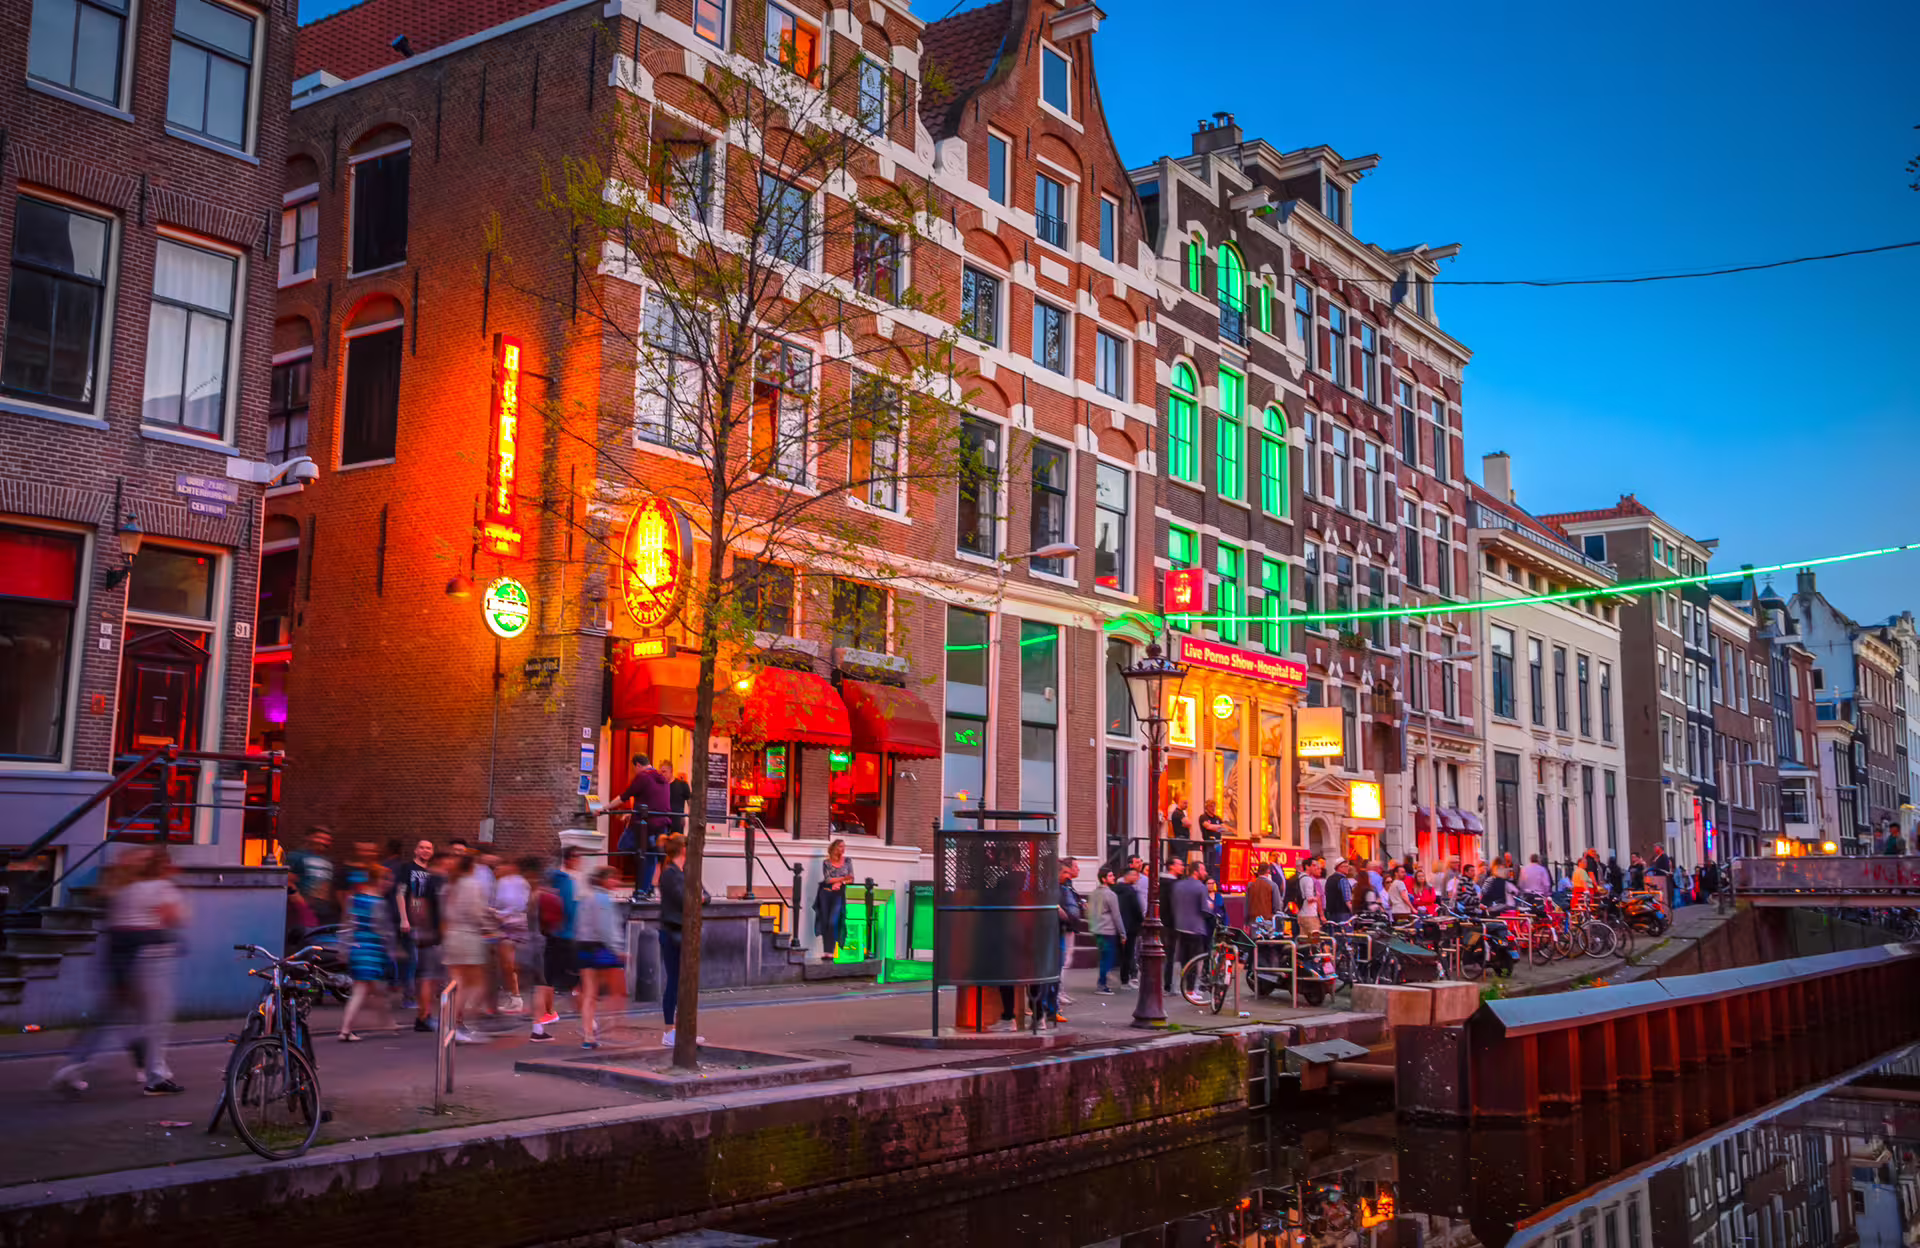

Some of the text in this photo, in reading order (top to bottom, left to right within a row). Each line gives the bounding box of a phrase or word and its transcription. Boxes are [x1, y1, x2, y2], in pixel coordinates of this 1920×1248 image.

[191, 502, 223, 515] CENTRUM
[237, 624, 248, 637] 91
[1184, 643, 1202, 660] Live
[1204, 647, 1230, 666] Porno
[1231, 653, 1254, 668] Show
[1257, 660, 1289, 680] Hospital
[1289, 667, 1303, 681] Bar
